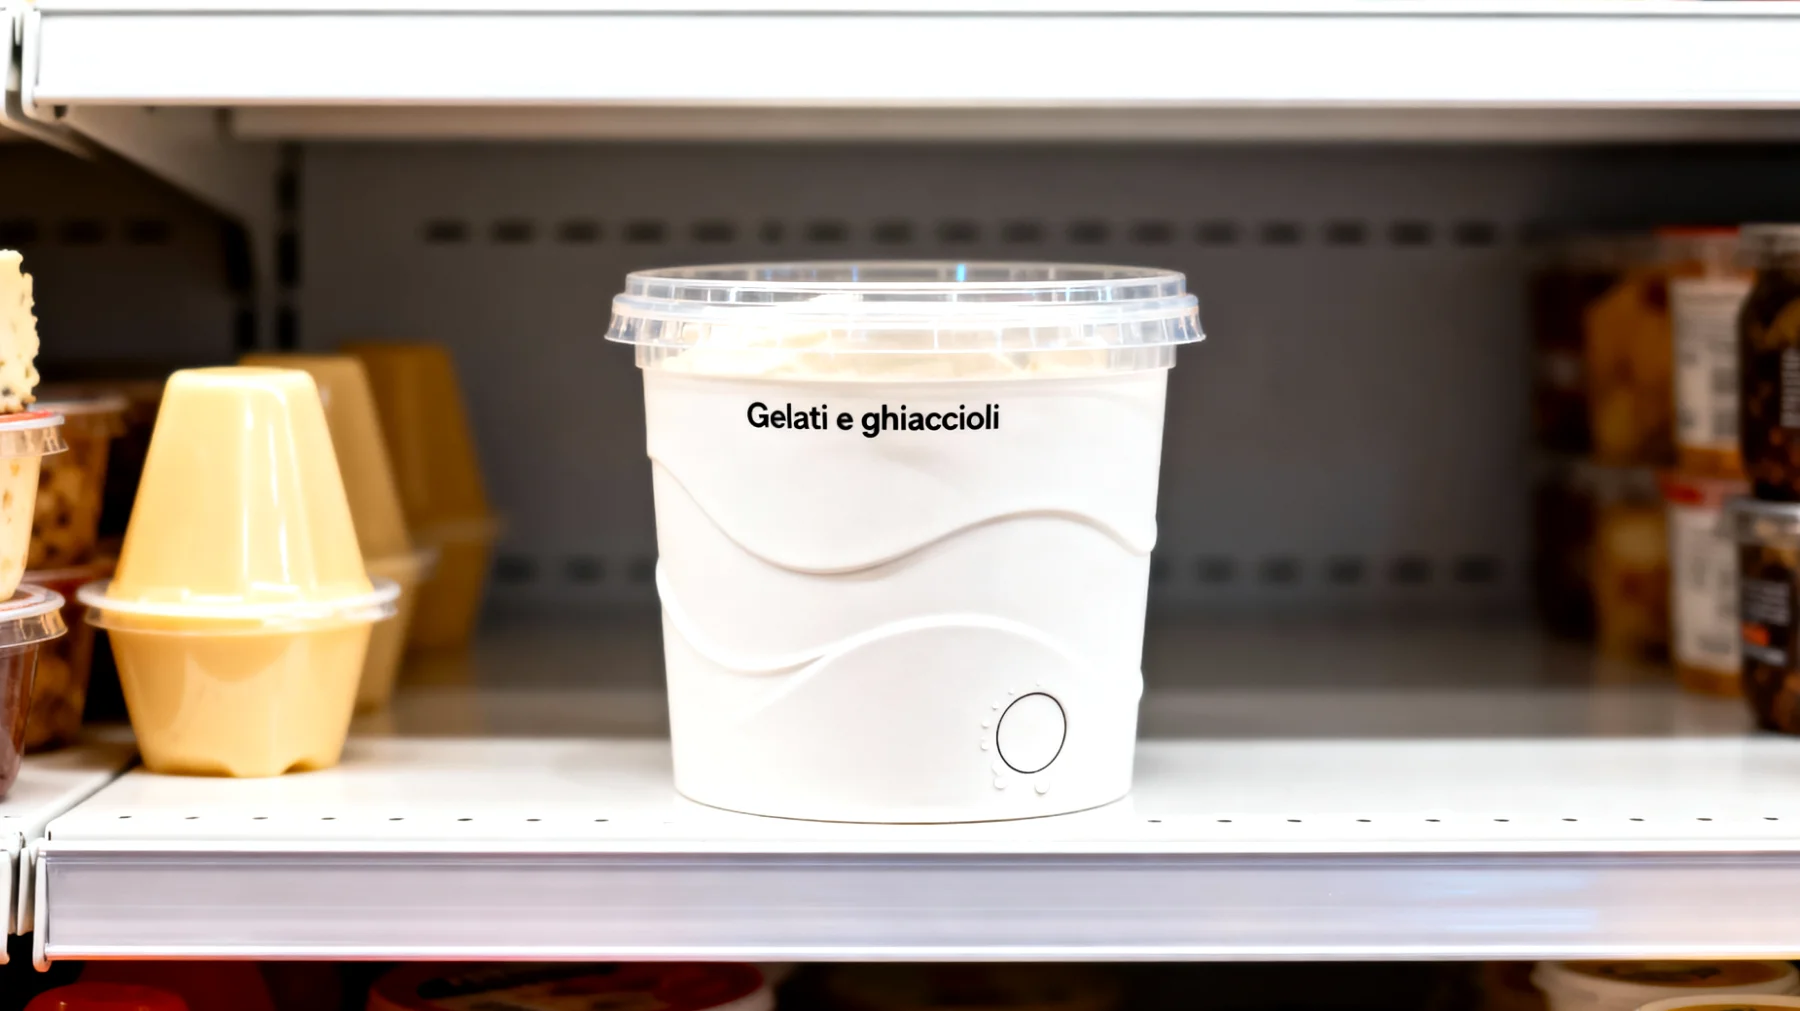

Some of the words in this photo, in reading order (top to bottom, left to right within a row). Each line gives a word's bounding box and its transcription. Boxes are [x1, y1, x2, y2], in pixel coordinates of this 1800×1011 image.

[747, 401, 827, 430] Gelati
[836, 412, 853, 431] e
[861, 403, 999, 439] ghiaccioli
